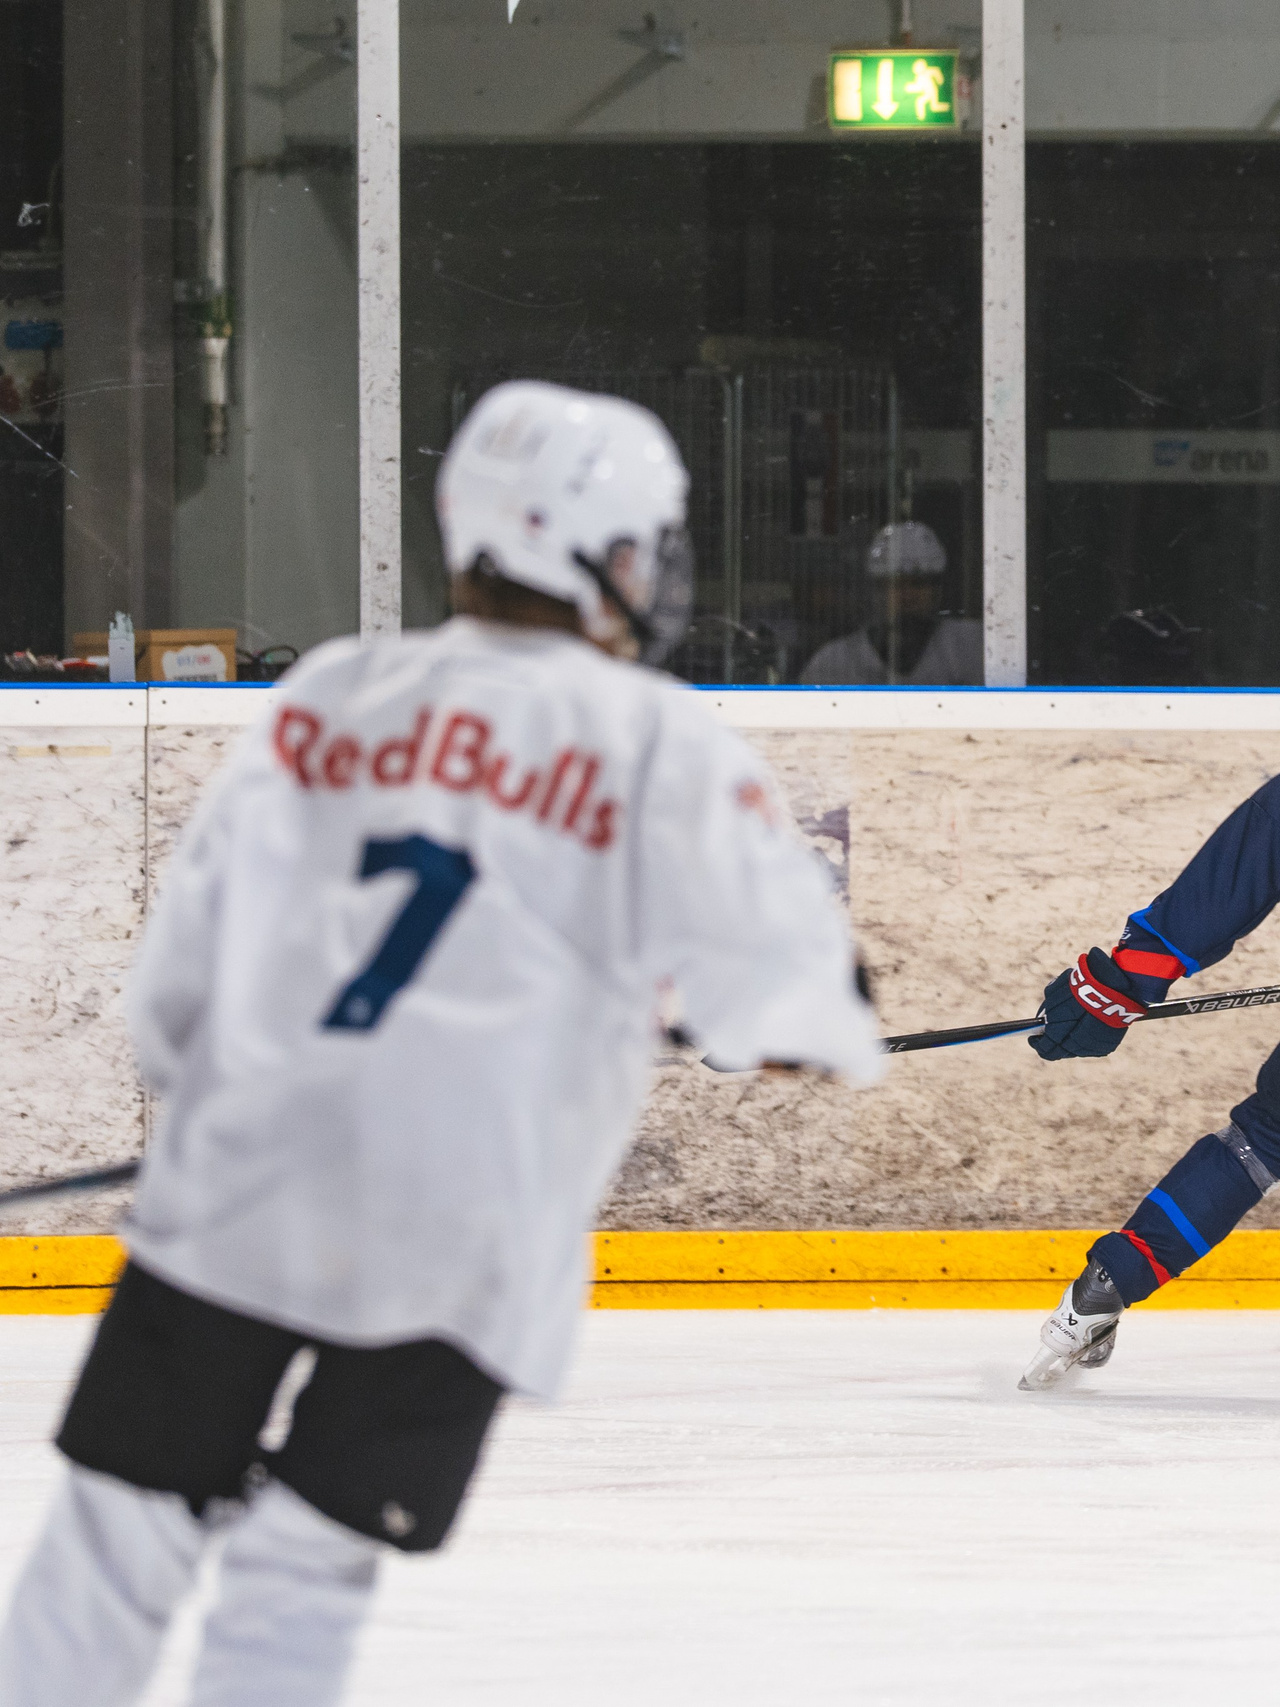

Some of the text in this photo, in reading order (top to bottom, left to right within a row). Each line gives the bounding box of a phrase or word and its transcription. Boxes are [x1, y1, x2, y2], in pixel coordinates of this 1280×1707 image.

[318, 831, 479, 1035] 7
[1069, 961, 1145, 1024] CCM
[1200, 992, 1280, 1012] BAUER
